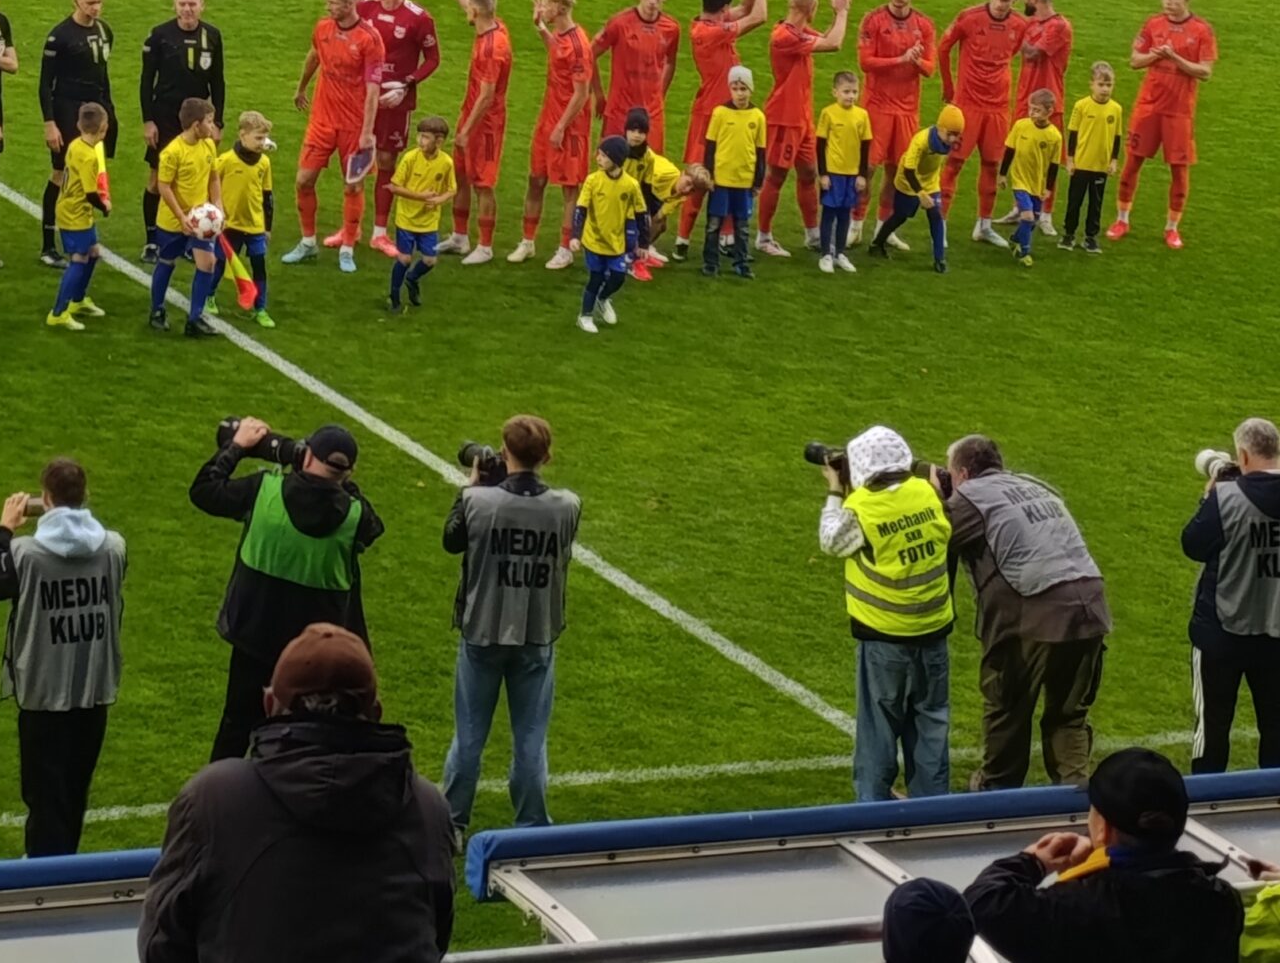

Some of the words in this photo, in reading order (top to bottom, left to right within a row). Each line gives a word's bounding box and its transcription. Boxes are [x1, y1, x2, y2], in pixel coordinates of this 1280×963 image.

[877, 507, 938, 538] Mechanik
[1021, 501, 1064, 525] KLUB
[491, 528, 558, 558] MEDIA
[898, 540, 935, 566] FOTO
[497, 560, 550, 589] KLUB
[40, 576, 109, 611] MEDIA
[50, 612, 105, 645] KLUB
